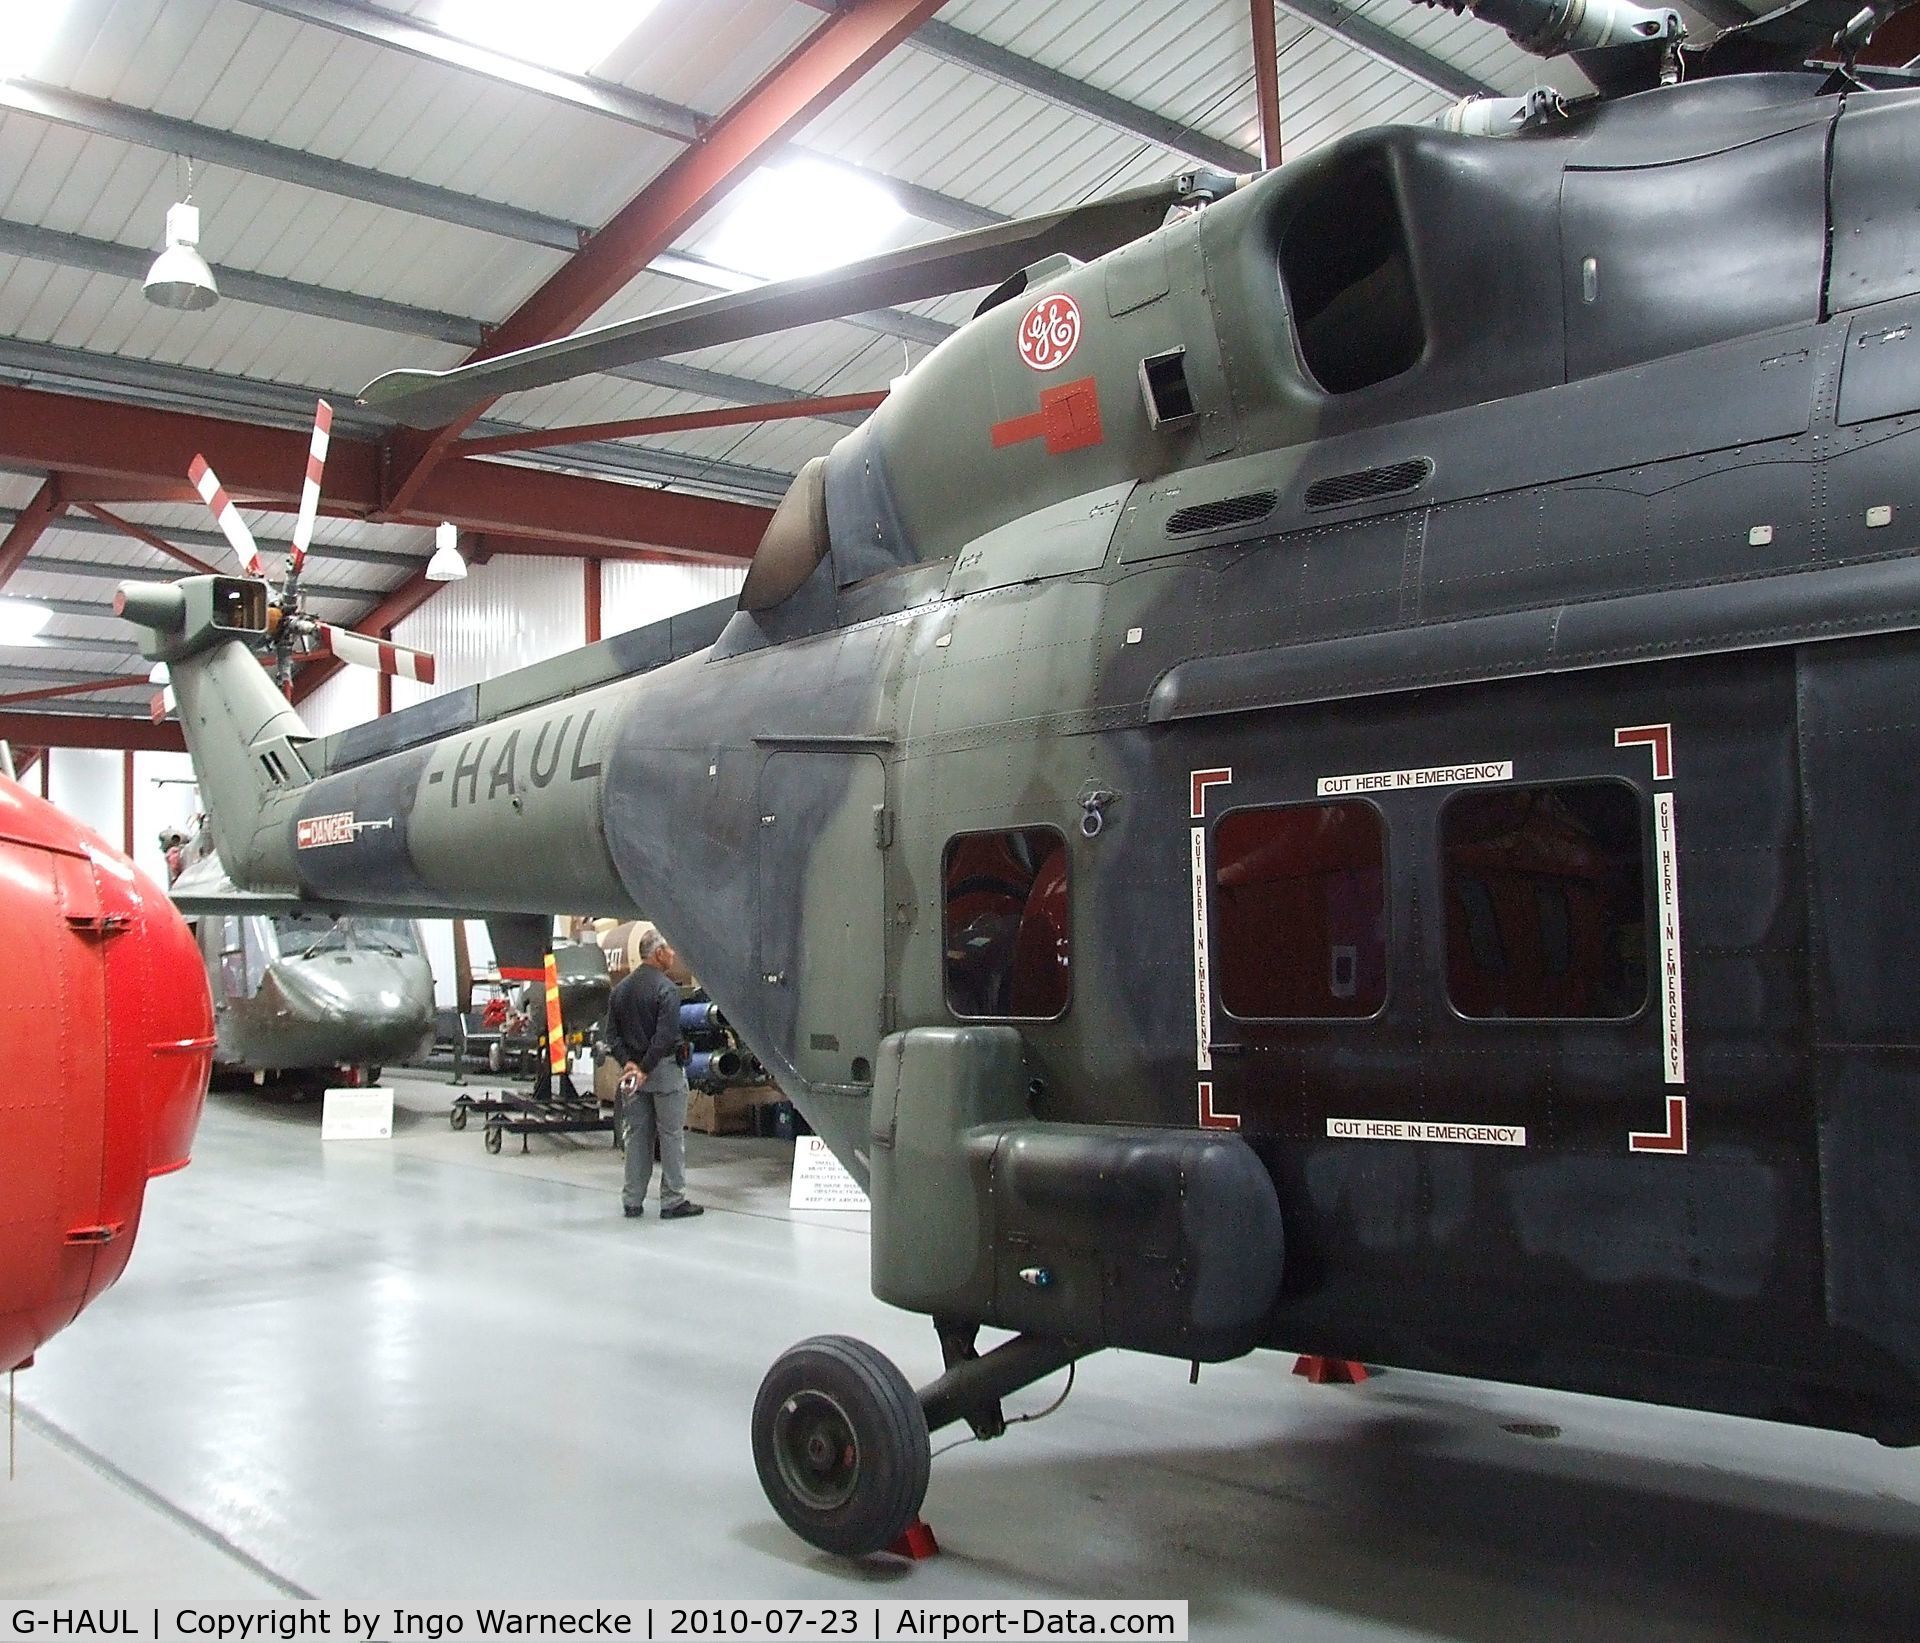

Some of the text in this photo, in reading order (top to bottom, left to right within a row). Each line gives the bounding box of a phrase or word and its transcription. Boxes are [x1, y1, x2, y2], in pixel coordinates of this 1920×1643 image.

[429, 709, 601, 807] -HAUL
[1324, 764, 1505, 793] CUT HERE IN EMERGENCY
[311, 816, 354, 844] DANGER
[1198, 927, 1204, 950] IN
[1660, 801, 1679, 1075] CUT HERE IN EMERGENCY
[1198, 956, 1209, 1064] EMERGENCY
[1334, 1122, 1517, 1142] CUT HERE IN EMERGENCY
